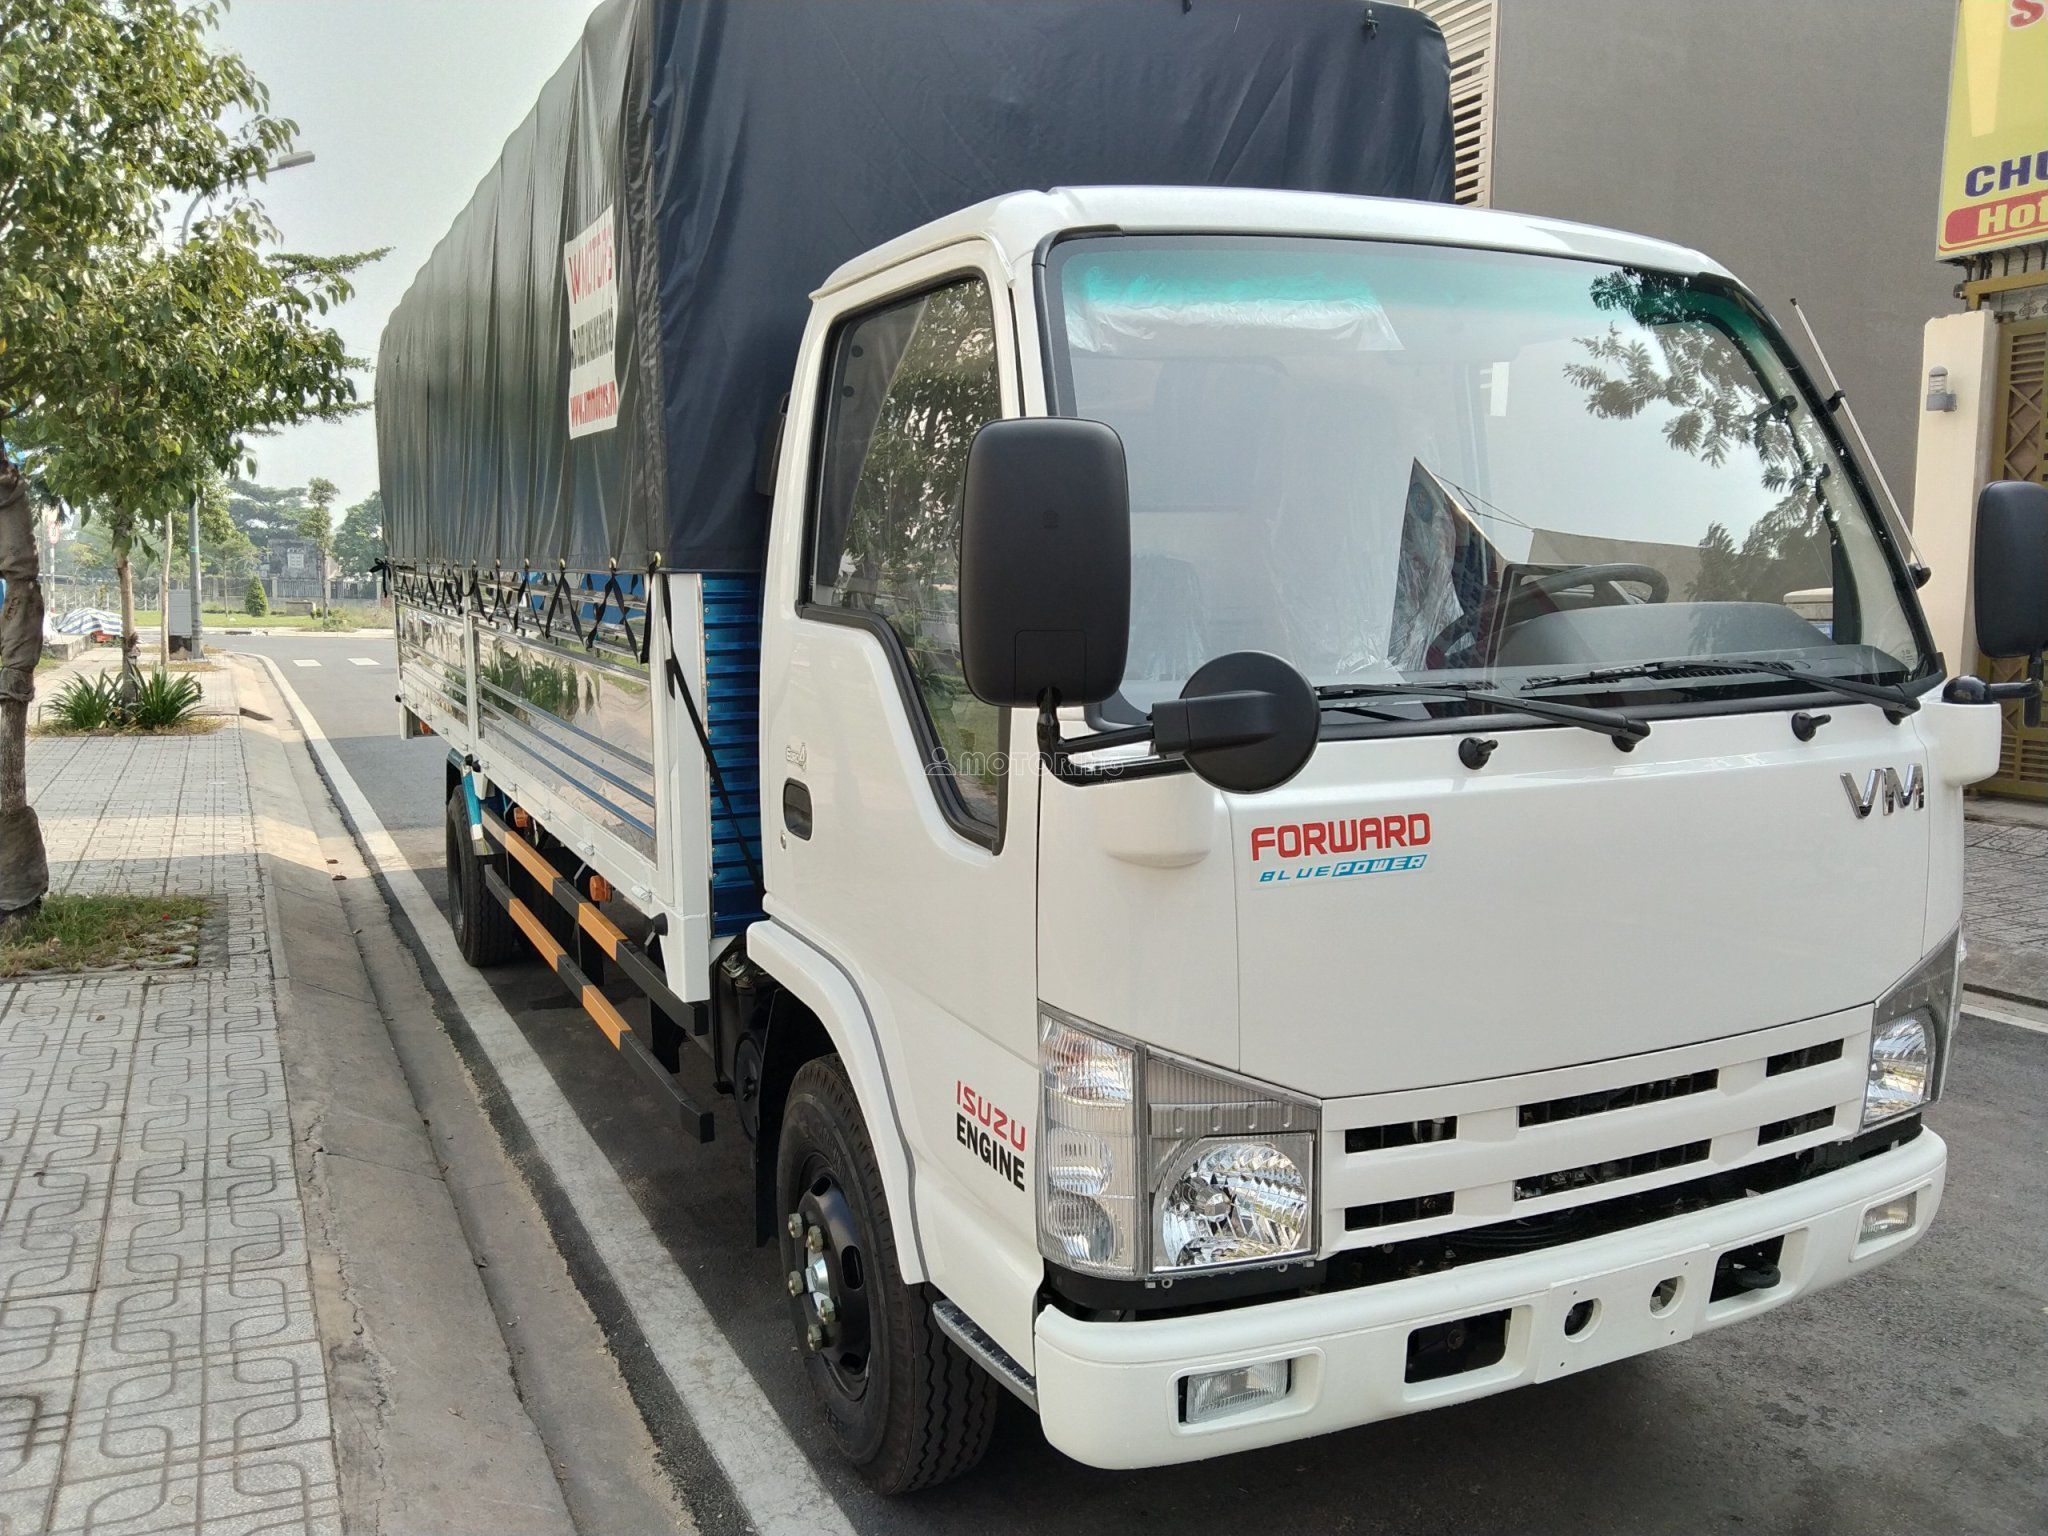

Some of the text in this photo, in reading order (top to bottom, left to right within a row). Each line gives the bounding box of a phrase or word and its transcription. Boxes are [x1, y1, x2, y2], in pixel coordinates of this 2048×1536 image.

[1840, 763, 1924, 819] VM
[1251, 813, 1431, 861] FORWARD
[957, 1080, 1025, 1152] ISUZU
[957, 1112, 1025, 1192] ENGINE
